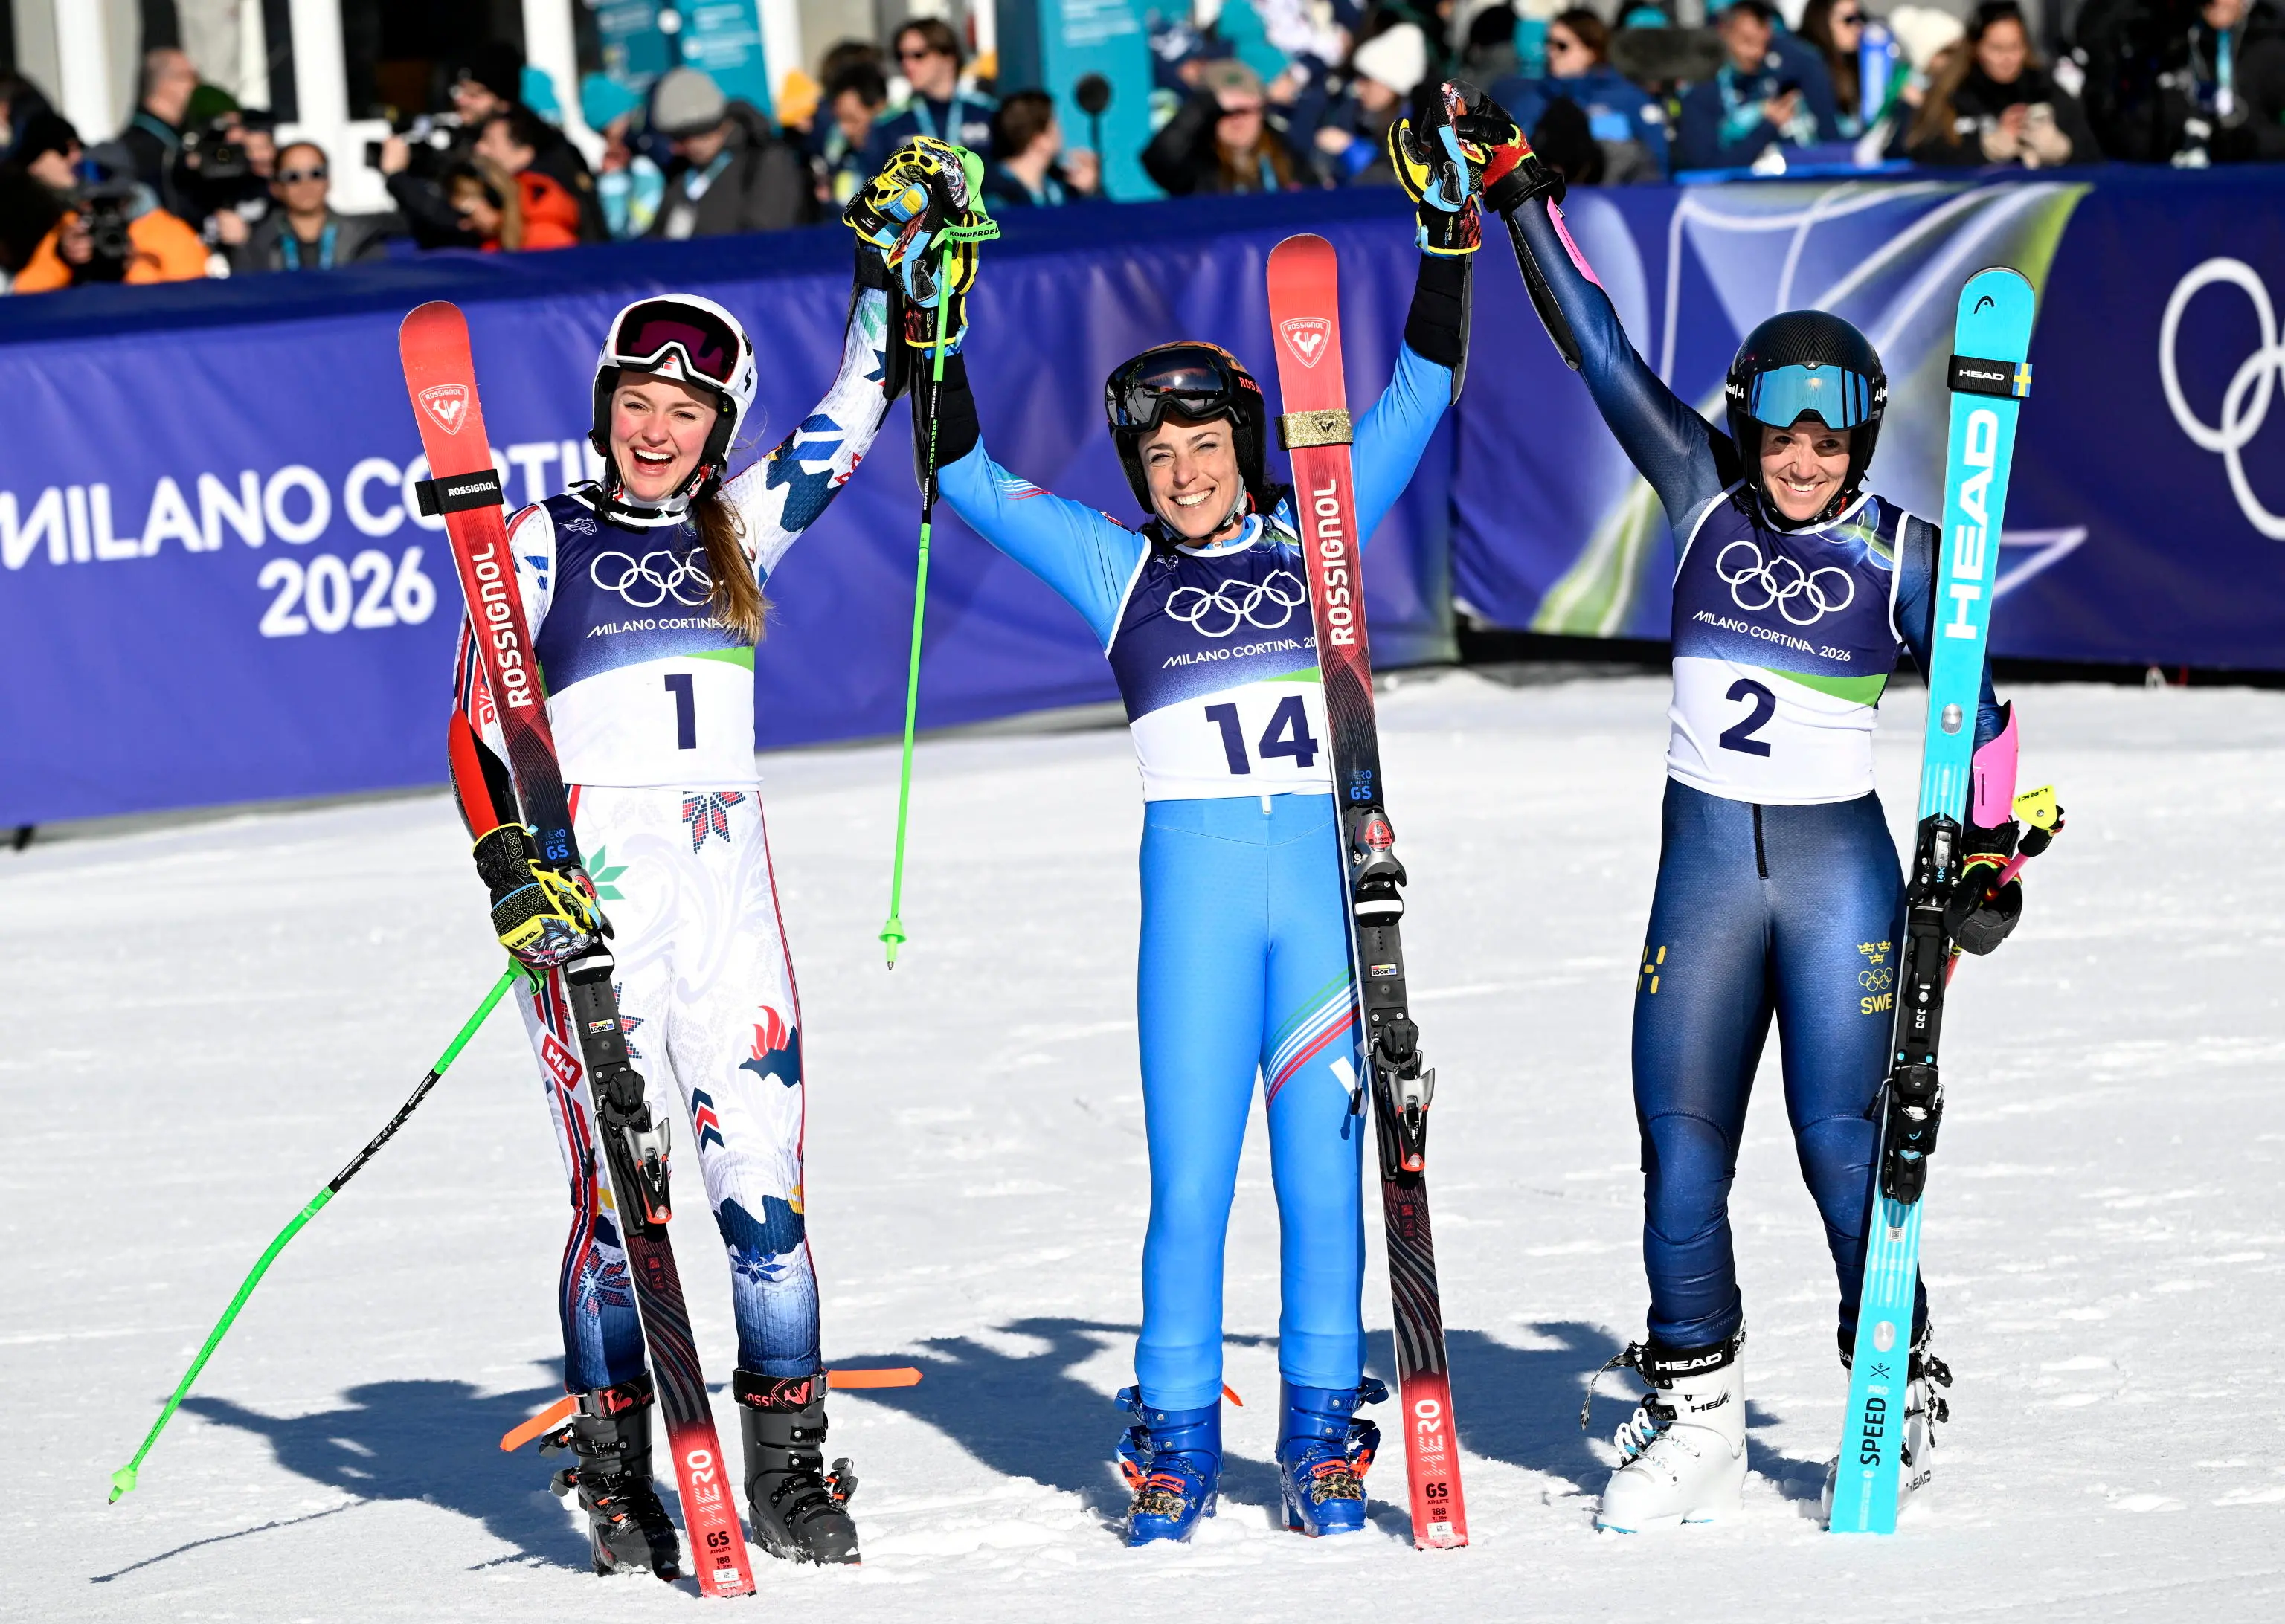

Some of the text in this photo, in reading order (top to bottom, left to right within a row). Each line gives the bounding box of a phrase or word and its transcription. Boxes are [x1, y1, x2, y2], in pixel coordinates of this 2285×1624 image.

[1287, 321, 1324, 331] ROSSIGNOL
[1958, 369, 2005, 381] HEAD
[425, 388, 463, 400] ROSSIGNOL
[929, 419, 937, 475] KOMPERDELL
[448, 481, 498, 497] ROSSIGNOL
[0, 464, 332, 570] MILANO
[1945, 409, 1999, 640] HEAD
[1313, 479, 1355, 645] ROSSIGNOL
[257, 547, 437, 638] 2026
[472, 542, 533, 709] ROSSIGNOL
[586, 619, 656, 639] MILANO
[1692, 610, 1851, 662] MILANO CORTINA 2026
[1161, 637, 1316, 669] MILANO CORTINA 20
[663, 673, 697, 750] 1
[1718, 677, 1777, 758] 2
[1204, 695, 1319, 775] 14
[1350, 785, 1372, 800] GS
[2018, 787, 2048, 802] LEKI
[546, 844, 568, 860] GS
[511, 929, 539, 948] LEVEL
[1860, 991, 1893, 1016] SWE
[591, 1025, 608, 1033] LOOK
[408, 1074, 433, 1106] KOMPERDELL
[338, 1152, 365, 1181] KOMPERDELL
[1655, 1352, 1723, 1371] HEAD
[1860, 1396, 1886, 1467] SPEED
[1425, 1482, 1448, 1498] GS
[1432, 1507, 1447, 1516] 188
[707, 1530, 730, 1547] GS
[710, 1546, 732, 1555] ATHLETE
[715, 1556, 730, 1565] 188
